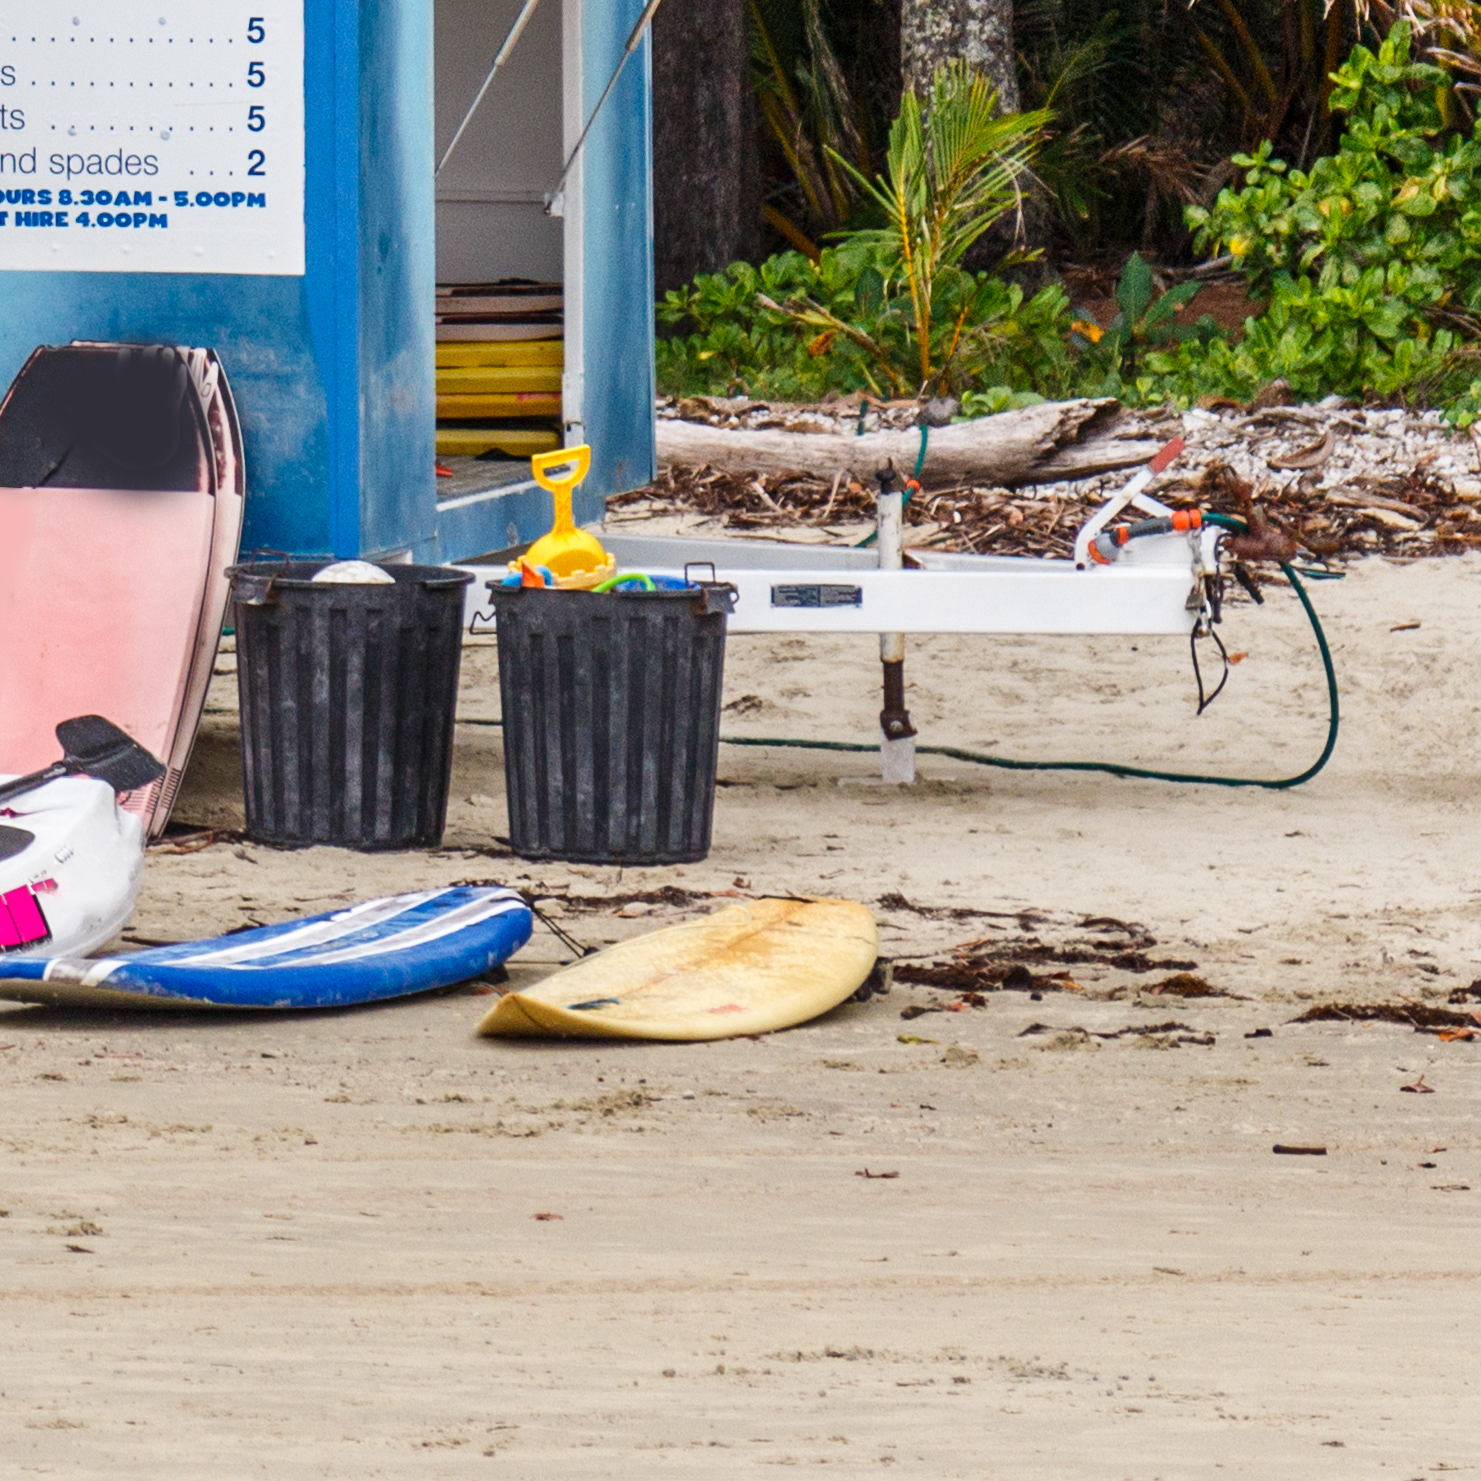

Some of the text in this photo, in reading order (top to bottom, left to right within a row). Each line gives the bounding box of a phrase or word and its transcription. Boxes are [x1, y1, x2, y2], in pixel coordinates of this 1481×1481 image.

[246, 16, 266, 45] 5
[246, 61, 266, 89] 5
[246, 105, 266, 133] 5
[49, 148, 159, 181] spades
[246, 149, 266, 177] 2
[57, 188, 153, 207] 8.30AM
[173, 190, 267, 209] 5.00PM
[14, 210, 70, 228] HIRE
[74, 211, 169, 229] 4.00PM
